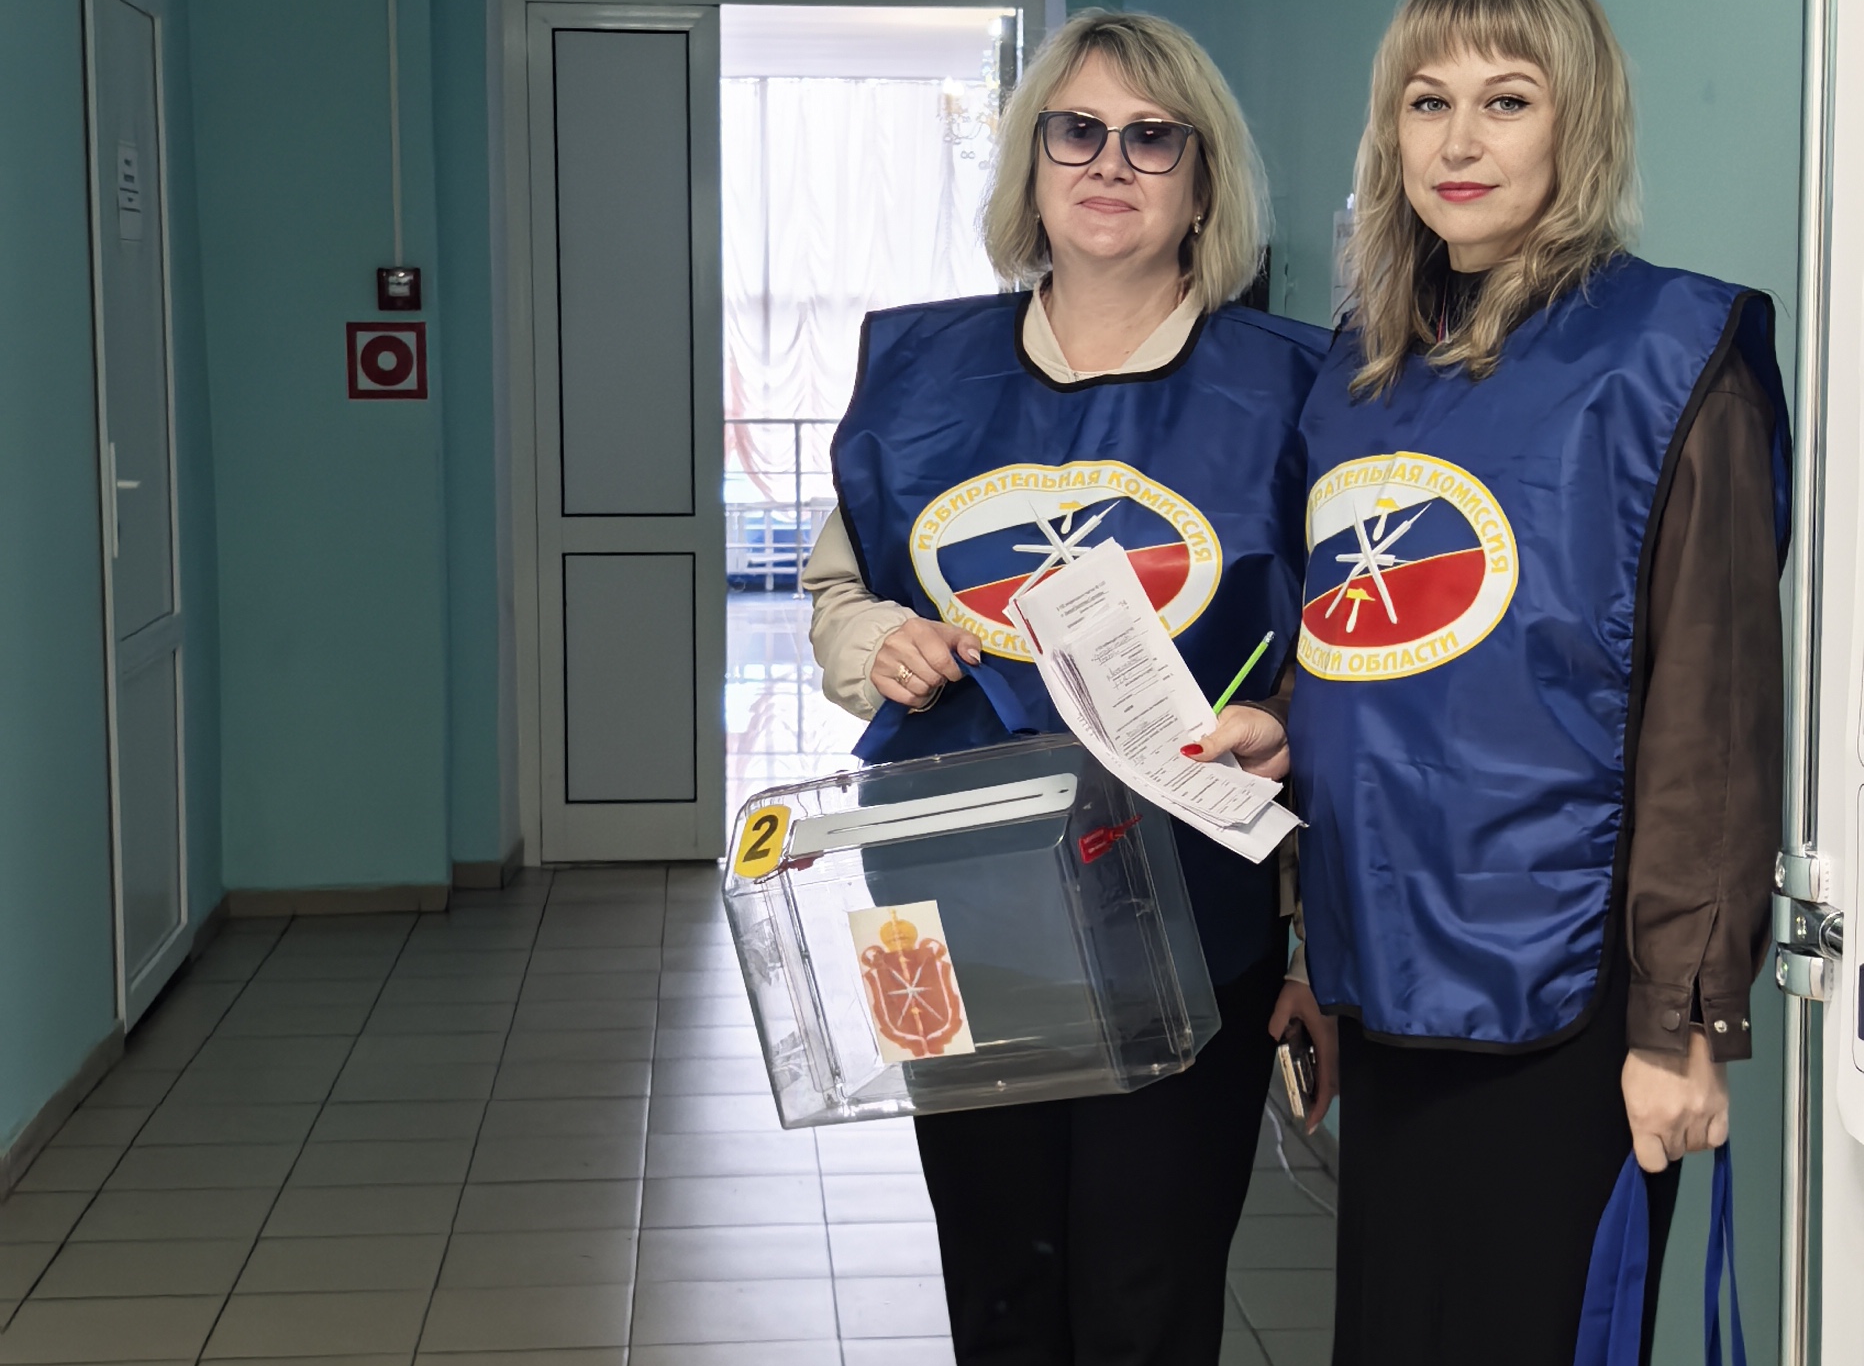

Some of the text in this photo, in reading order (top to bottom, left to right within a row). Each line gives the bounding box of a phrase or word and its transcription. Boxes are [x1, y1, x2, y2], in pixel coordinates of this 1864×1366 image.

[918, 469, 1213, 564] ИЗБИРАТЕЛЬНАЯ КОМИССИЯ
[1426, 468, 1510, 574] КОМИССИЯ
[1348, 631, 1460, 673] ОБЛАСТИ
[742, 814, 779, 863] 2
